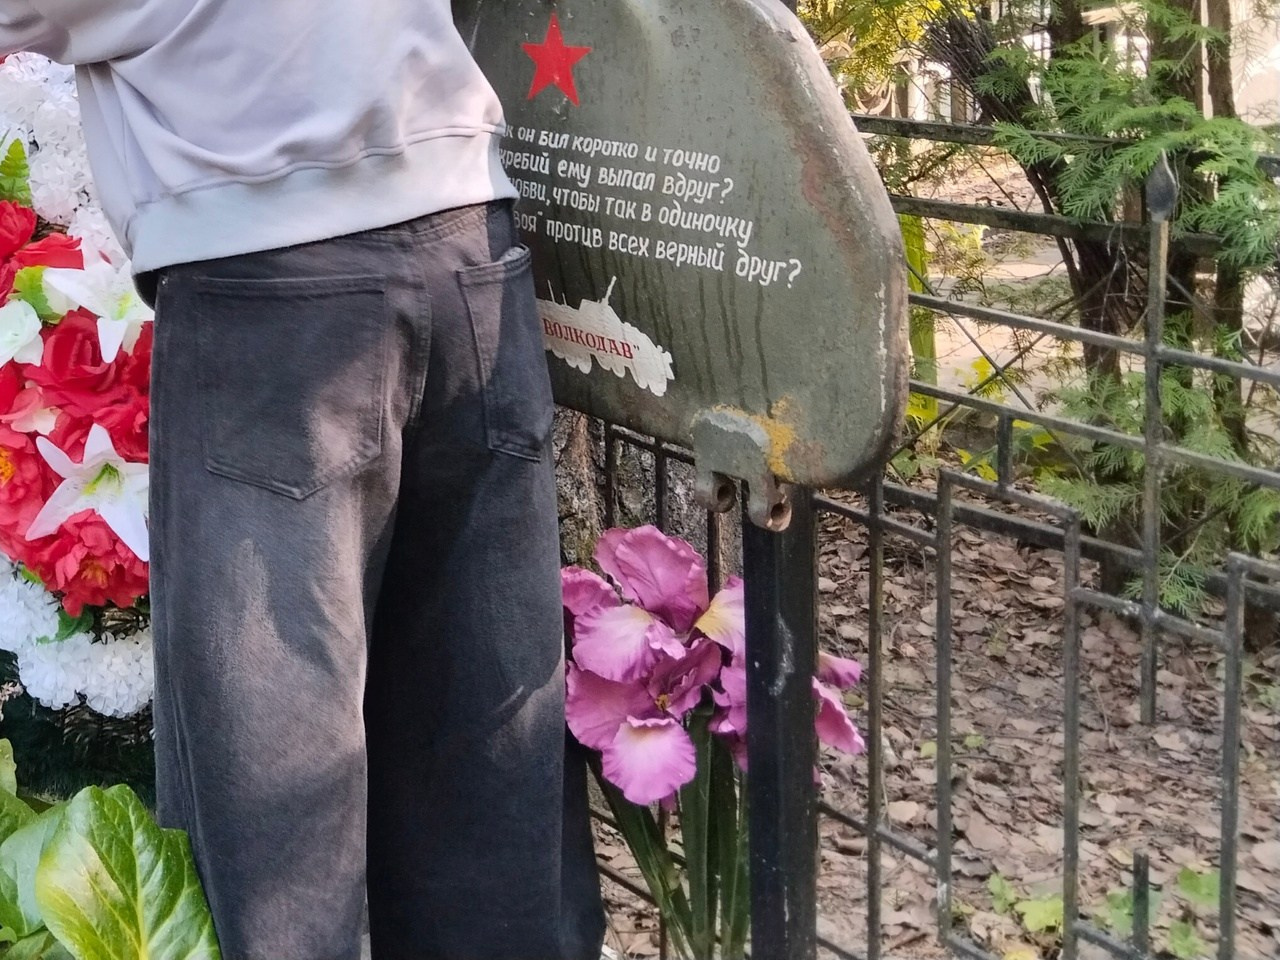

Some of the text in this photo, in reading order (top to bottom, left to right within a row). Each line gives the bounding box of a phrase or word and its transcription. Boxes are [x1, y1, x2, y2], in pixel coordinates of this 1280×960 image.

[517, 126, 536, 143] он
[572, 135, 639, 158] коротко
[644, 145, 658, 162] и
[663, 148, 721, 174] точно
[557, 159, 592, 189] ему
[598, 166, 656, 192] выпал
[662, 171, 734, 205] вдруг?
[552, 186, 601, 213] чтобы
[605, 196, 637, 220] так
[641, 202, 652, 223] в
[658, 199, 753, 248] одиночку
[546, 218, 603, 249] против
[608, 230, 650, 258] всех
[655, 240, 725, 272] верный
[735, 248, 802, 289] друг?
